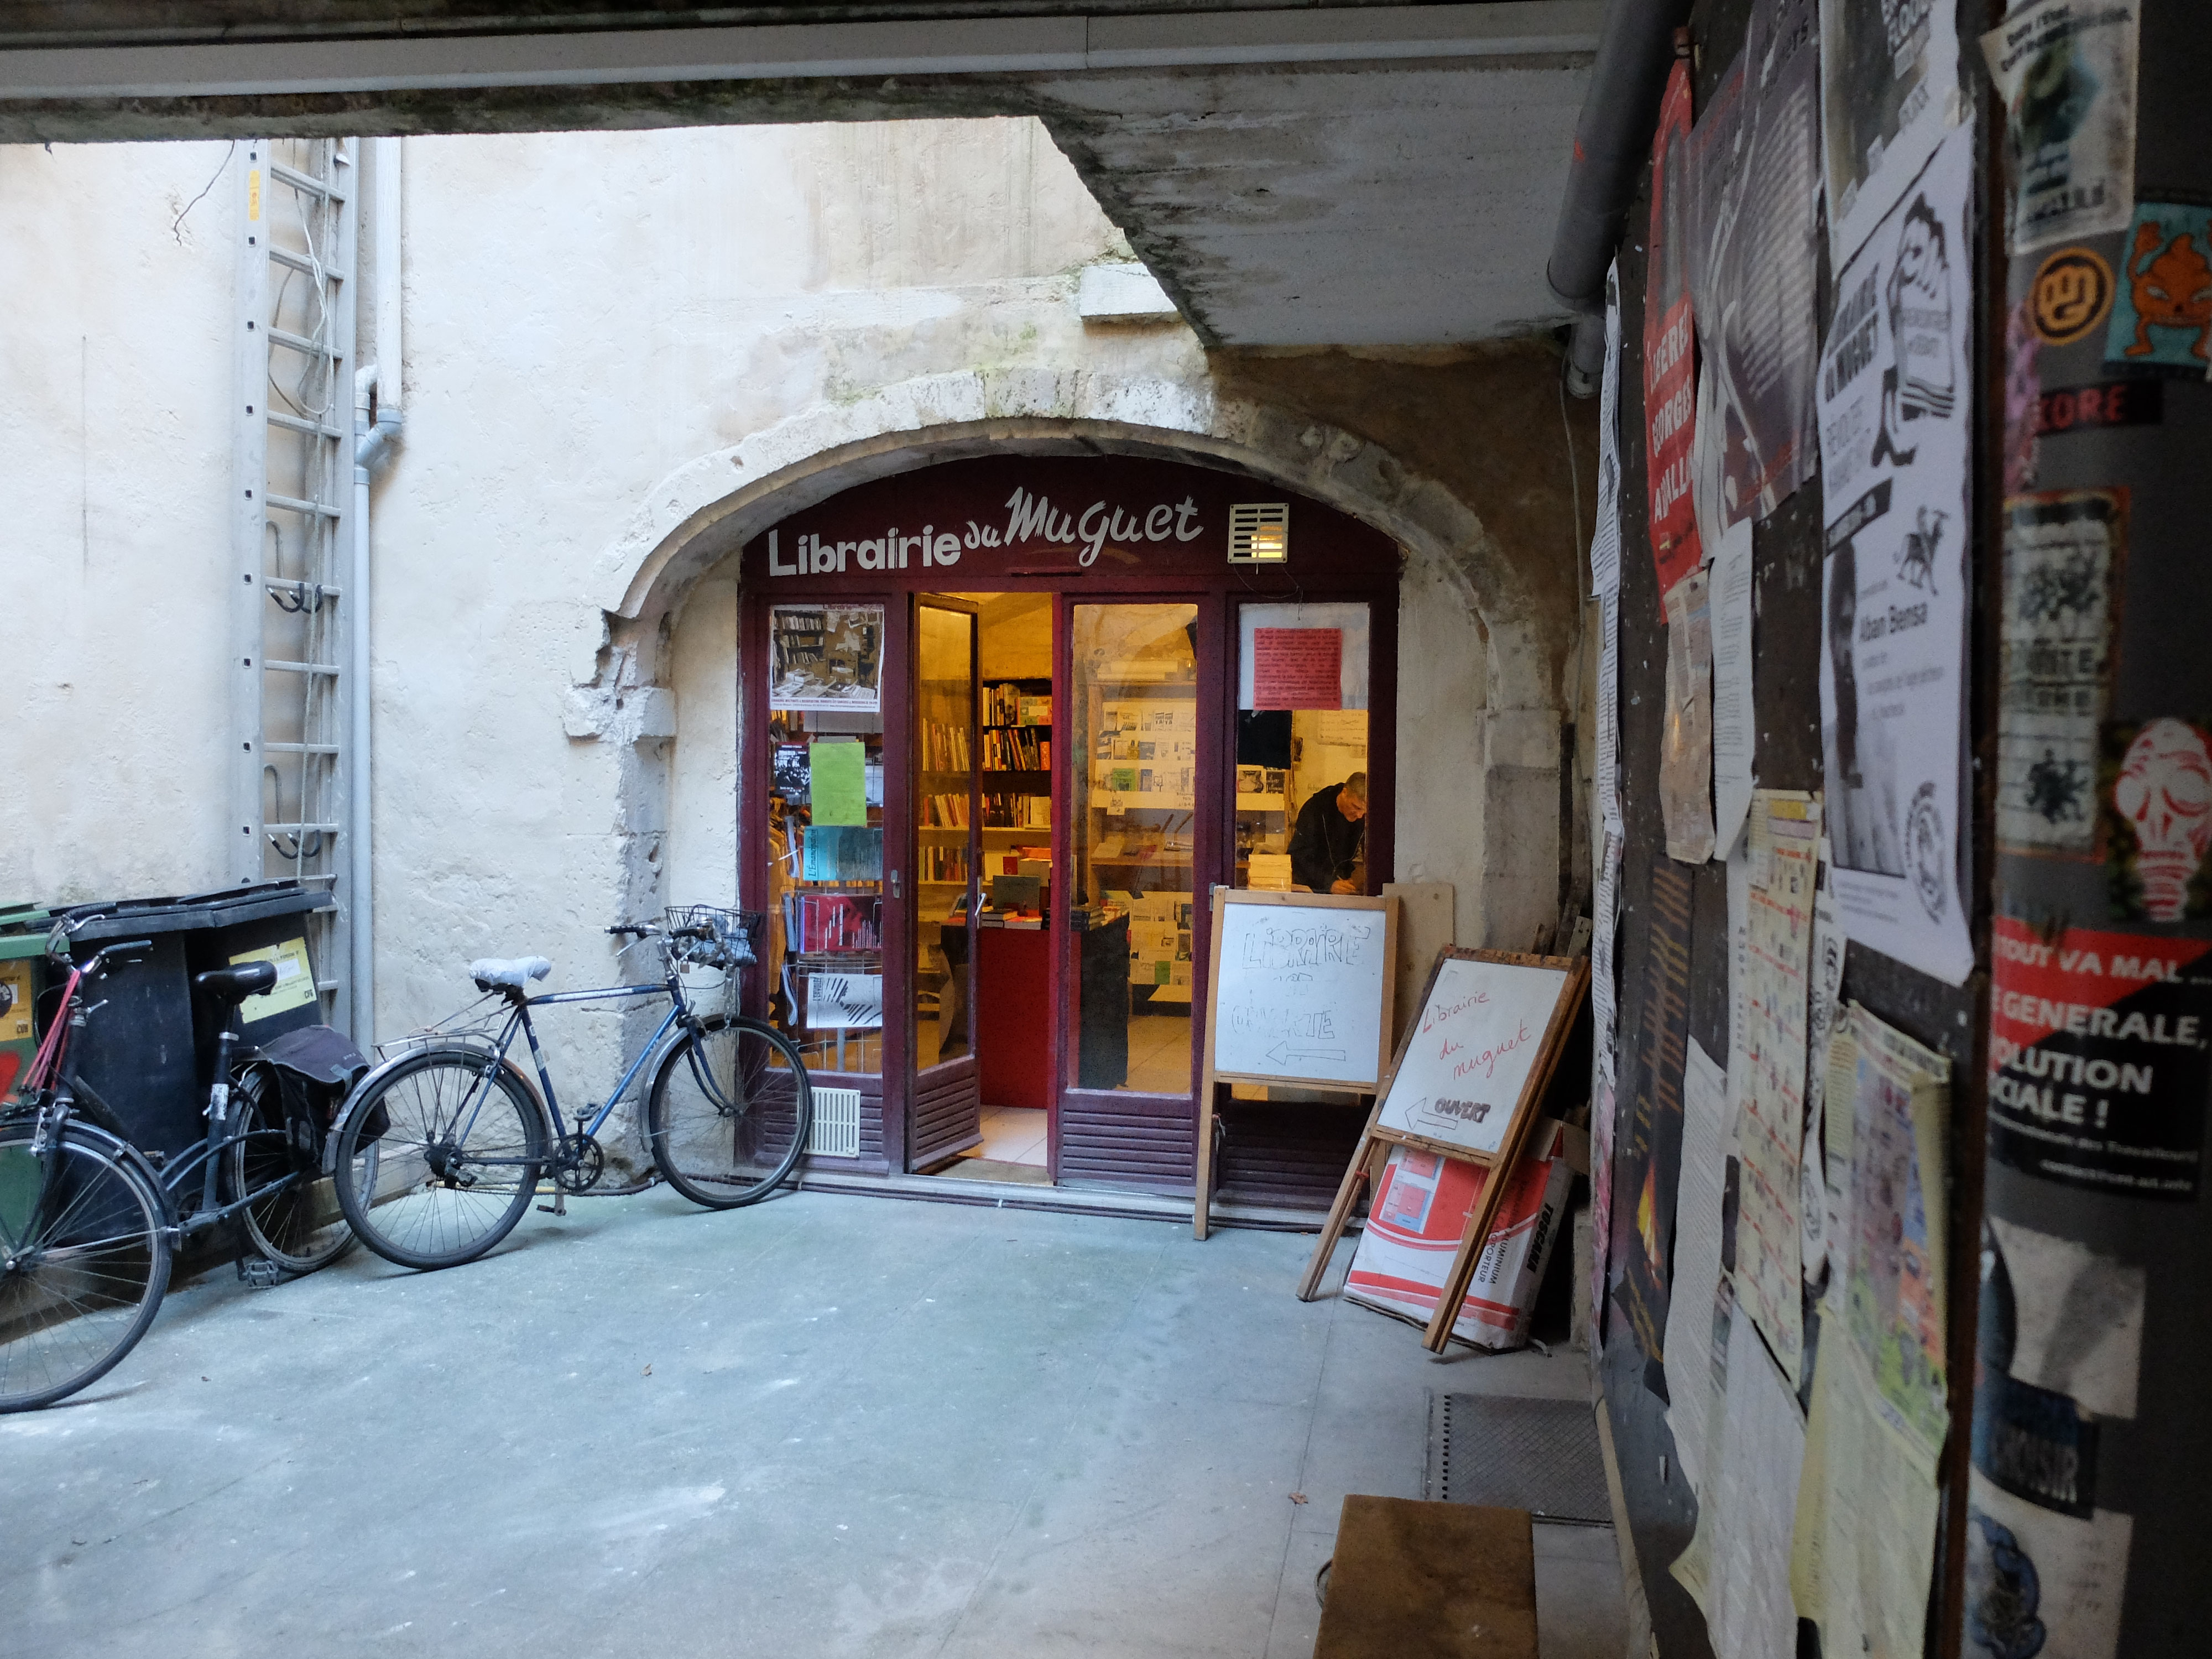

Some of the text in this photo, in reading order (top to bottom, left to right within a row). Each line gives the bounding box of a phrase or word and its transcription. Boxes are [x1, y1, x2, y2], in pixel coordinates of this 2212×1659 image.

[769, 487, 1204, 576] Librairie du Muguet
[1888, 601, 1928, 633] Bensa
[2059, 949, 2103, 976] VA
[2110, 955, 2183, 984] MAL
[1422, 991, 1490, 1034] Librairie
[1439, 1037, 1464, 1061] du
[1434, 1097, 1491, 1124] OUVERT
[1488, 1230, 1511, 1285] ALUMINIUM
[1527, 1202, 1554, 1274] TOSCANA
